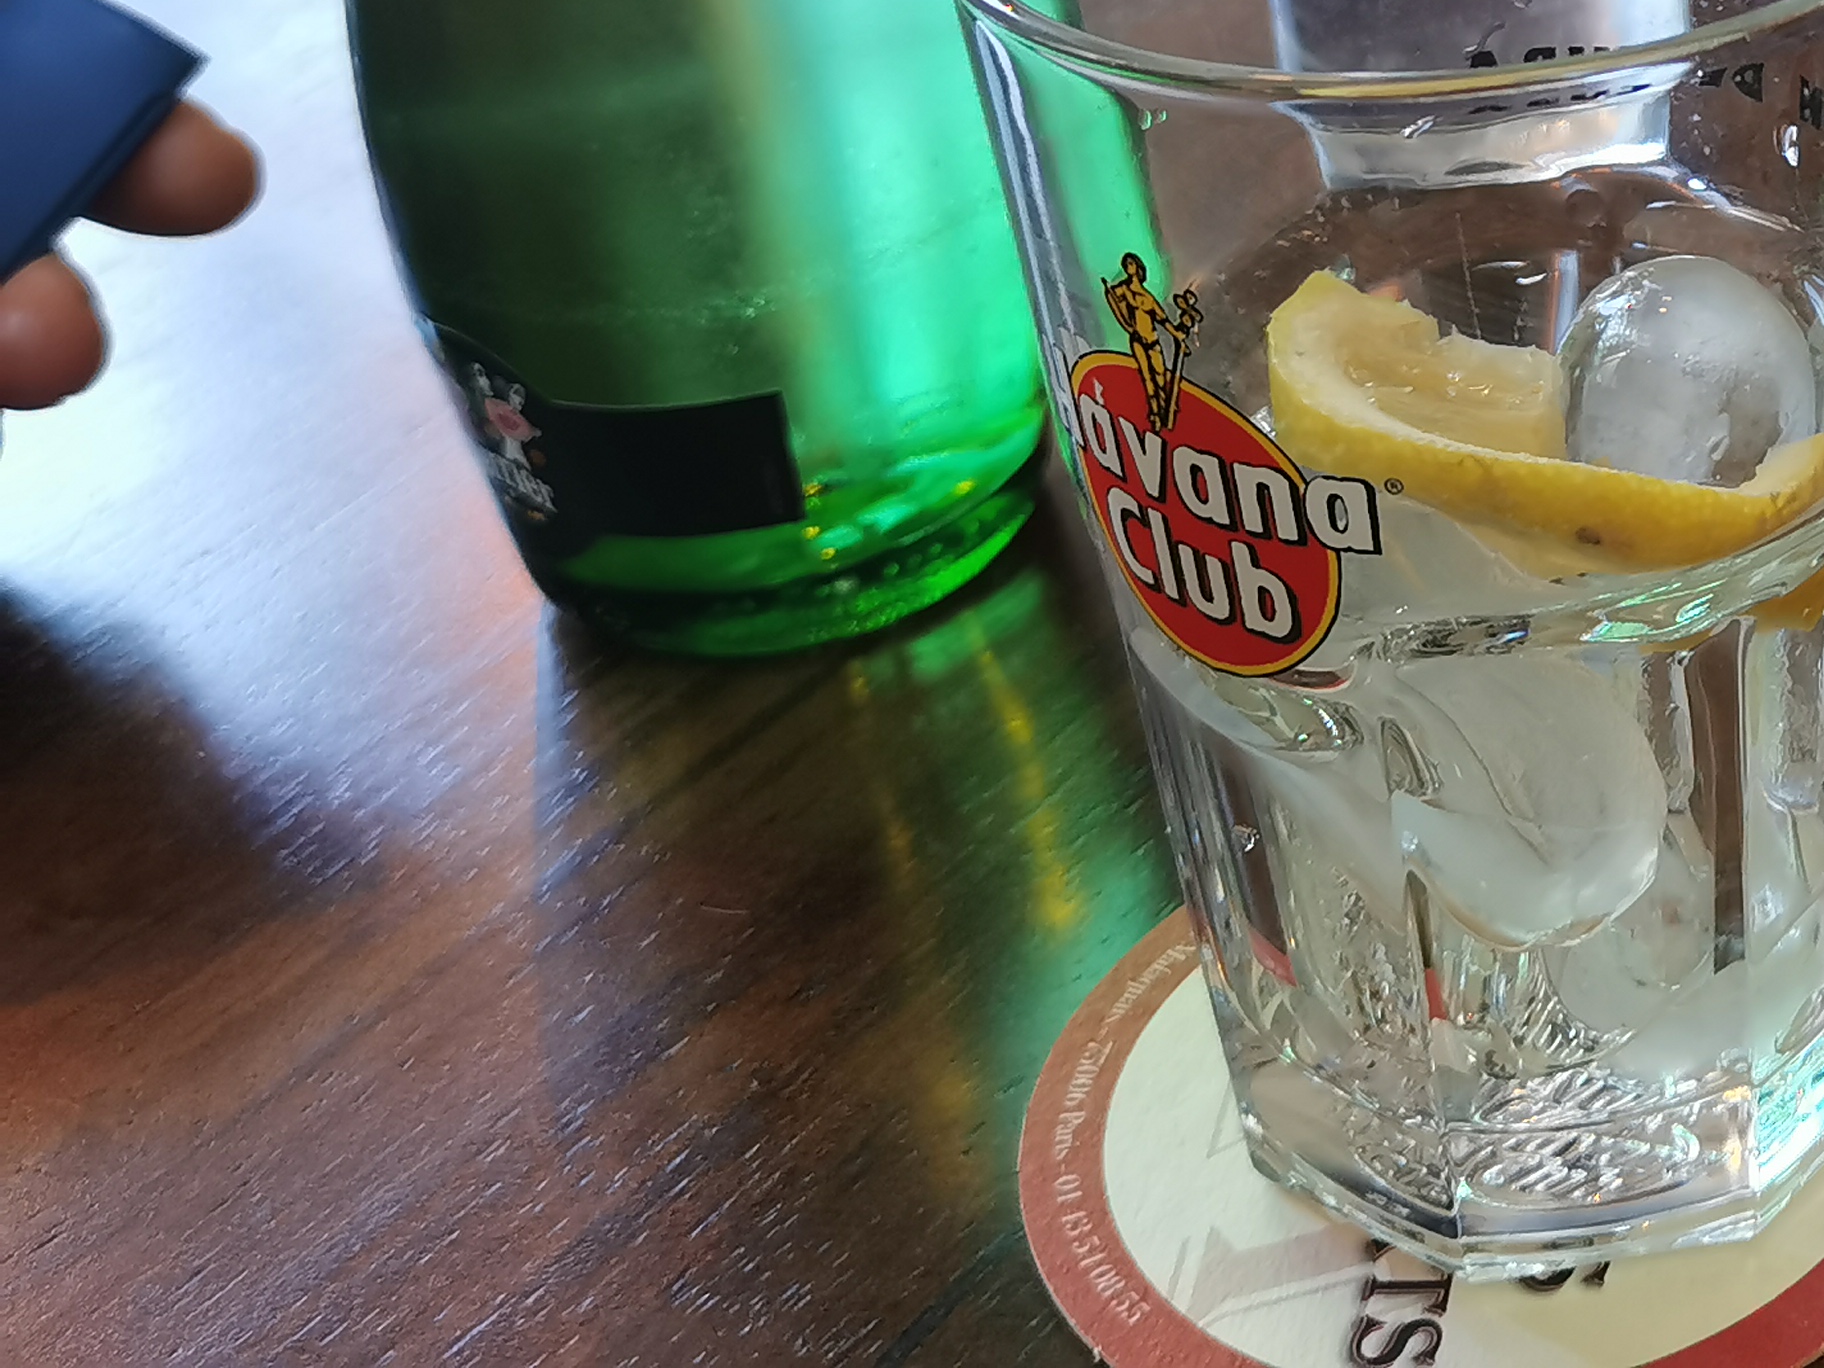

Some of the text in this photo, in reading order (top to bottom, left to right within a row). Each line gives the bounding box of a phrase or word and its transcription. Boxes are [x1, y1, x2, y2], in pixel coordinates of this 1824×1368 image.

[1106, 487, 1303, 642] Club
[1064, 1040, 1113, 1106] 75006
[1054, 1110, 1086, 1160] Paris
[1054, 1174, 1083, 1203] 01
[1089, 1264, 1126, 1298] 08
[1110, 1291, 1150, 1326] 55
